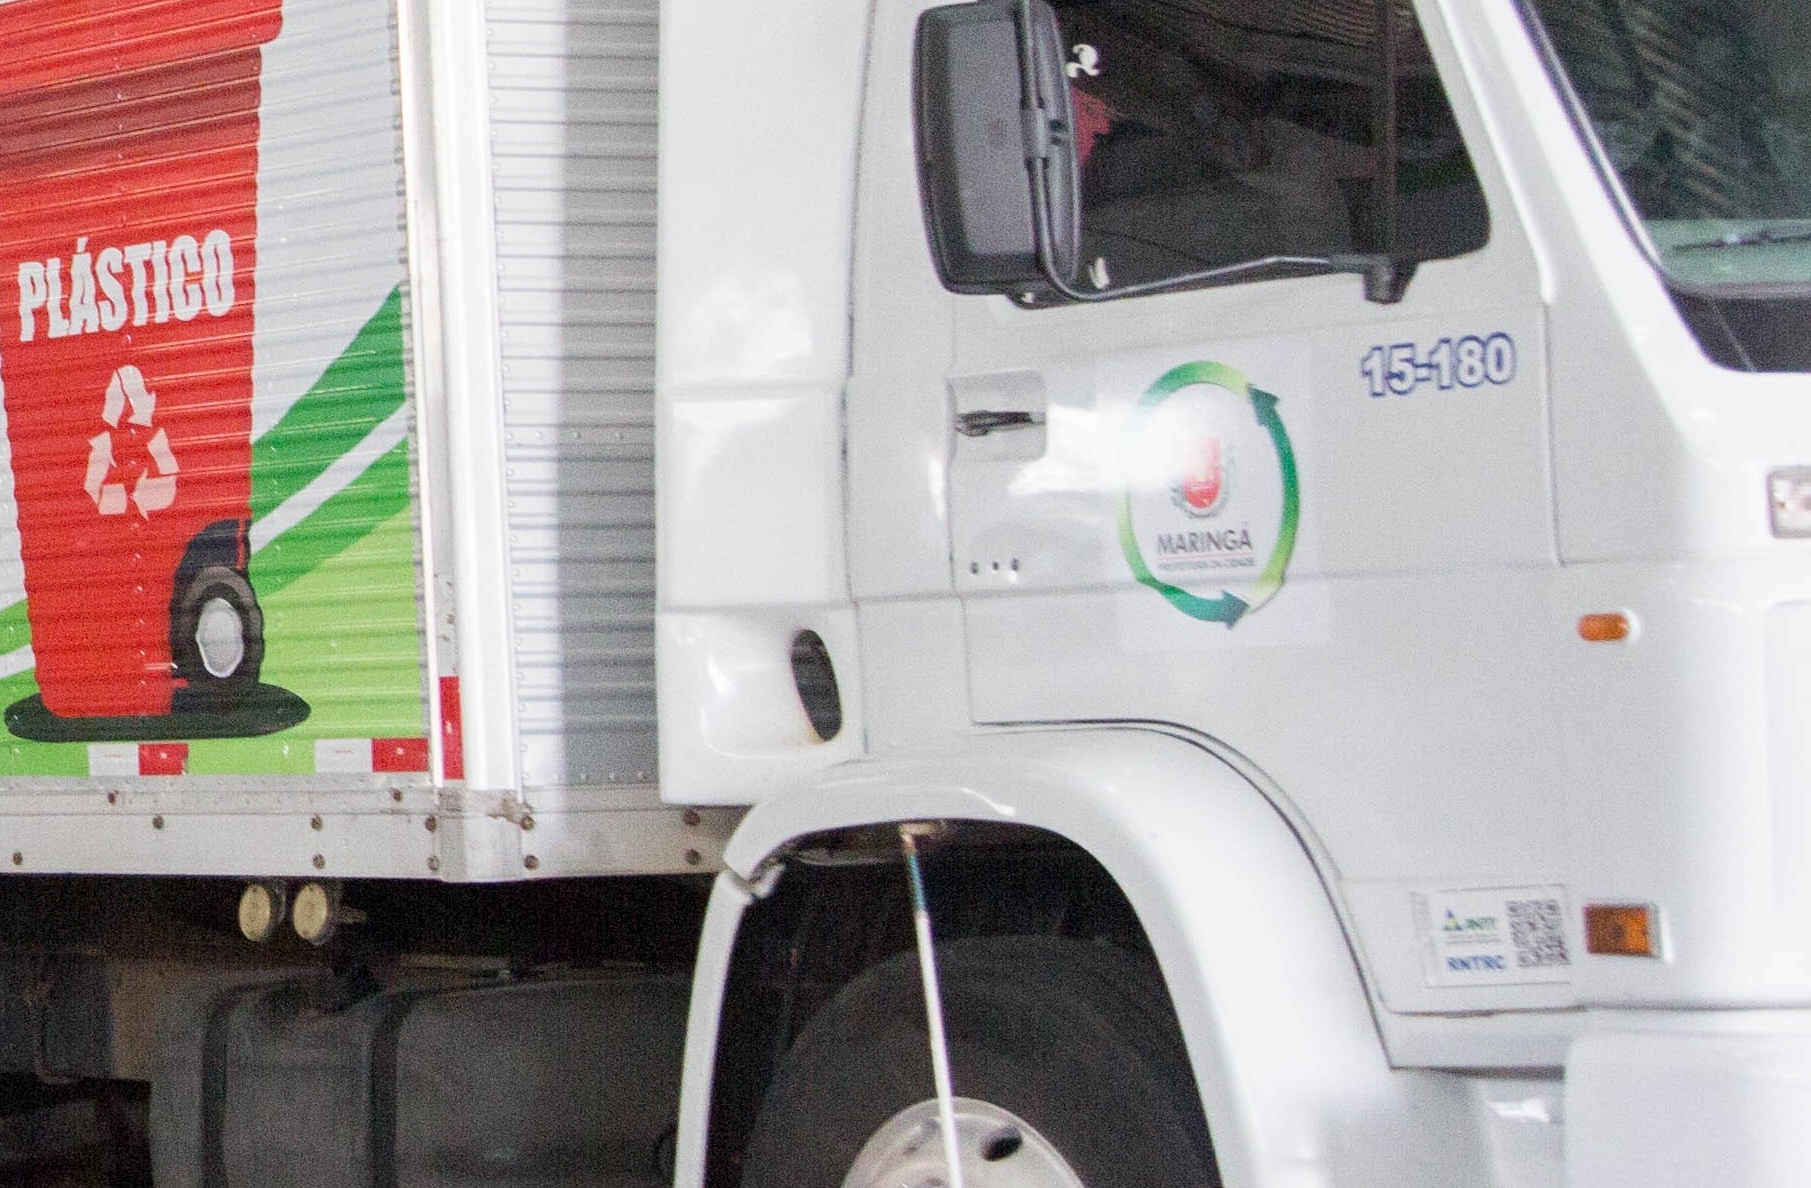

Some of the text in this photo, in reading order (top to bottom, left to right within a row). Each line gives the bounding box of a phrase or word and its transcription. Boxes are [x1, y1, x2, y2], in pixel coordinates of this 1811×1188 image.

[17, 229, 236, 343] PLÁSTICO
[1361, 331, 1517, 398] 15-180
[1157, 521, 1254, 554] MARINGÁ
